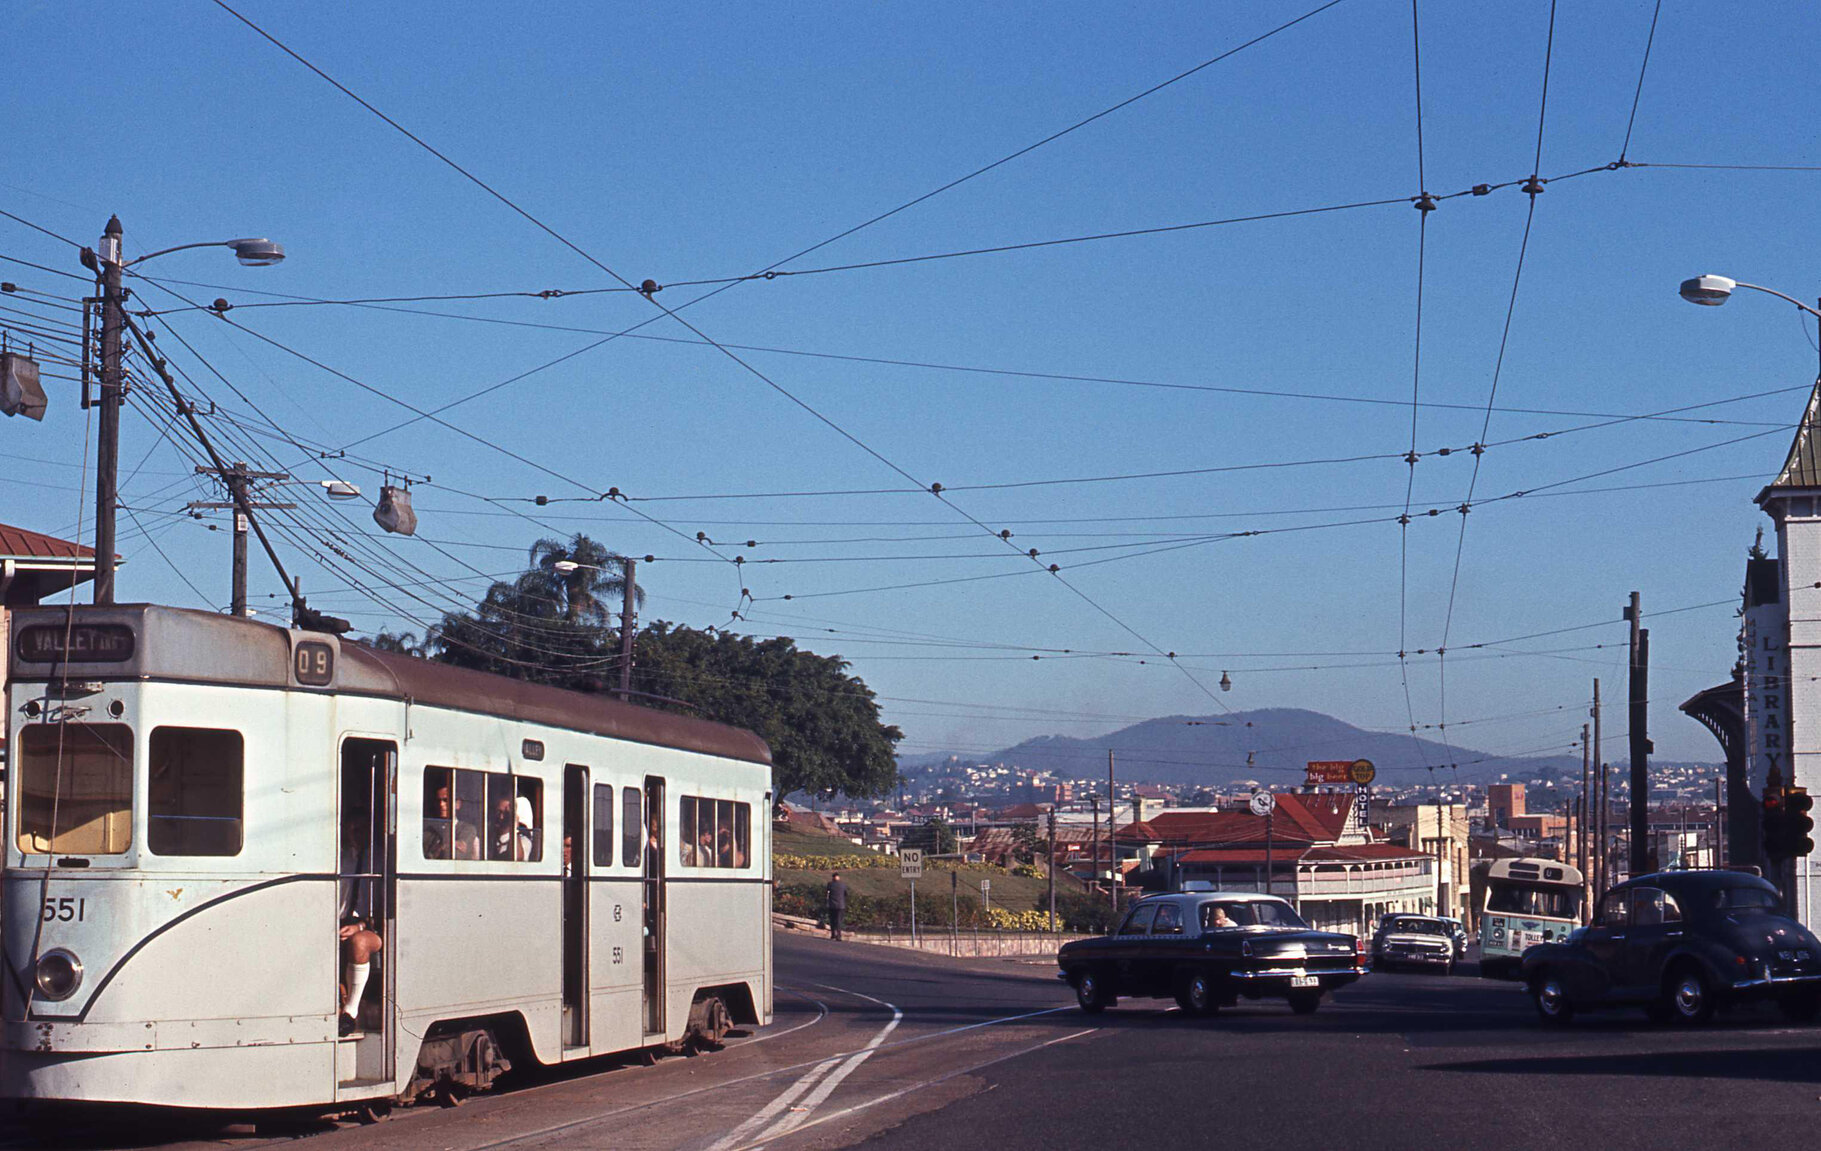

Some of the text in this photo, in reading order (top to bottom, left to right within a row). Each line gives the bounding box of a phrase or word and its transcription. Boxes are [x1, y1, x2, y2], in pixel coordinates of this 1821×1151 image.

[1762, 636, 1781, 767] LIBRARY
[1309, 772, 1325, 783] big
[1358, 786, 1368, 826] HOTEL
[903, 852, 919, 863] NO
[902, 866, 921, 874] ENTRY
